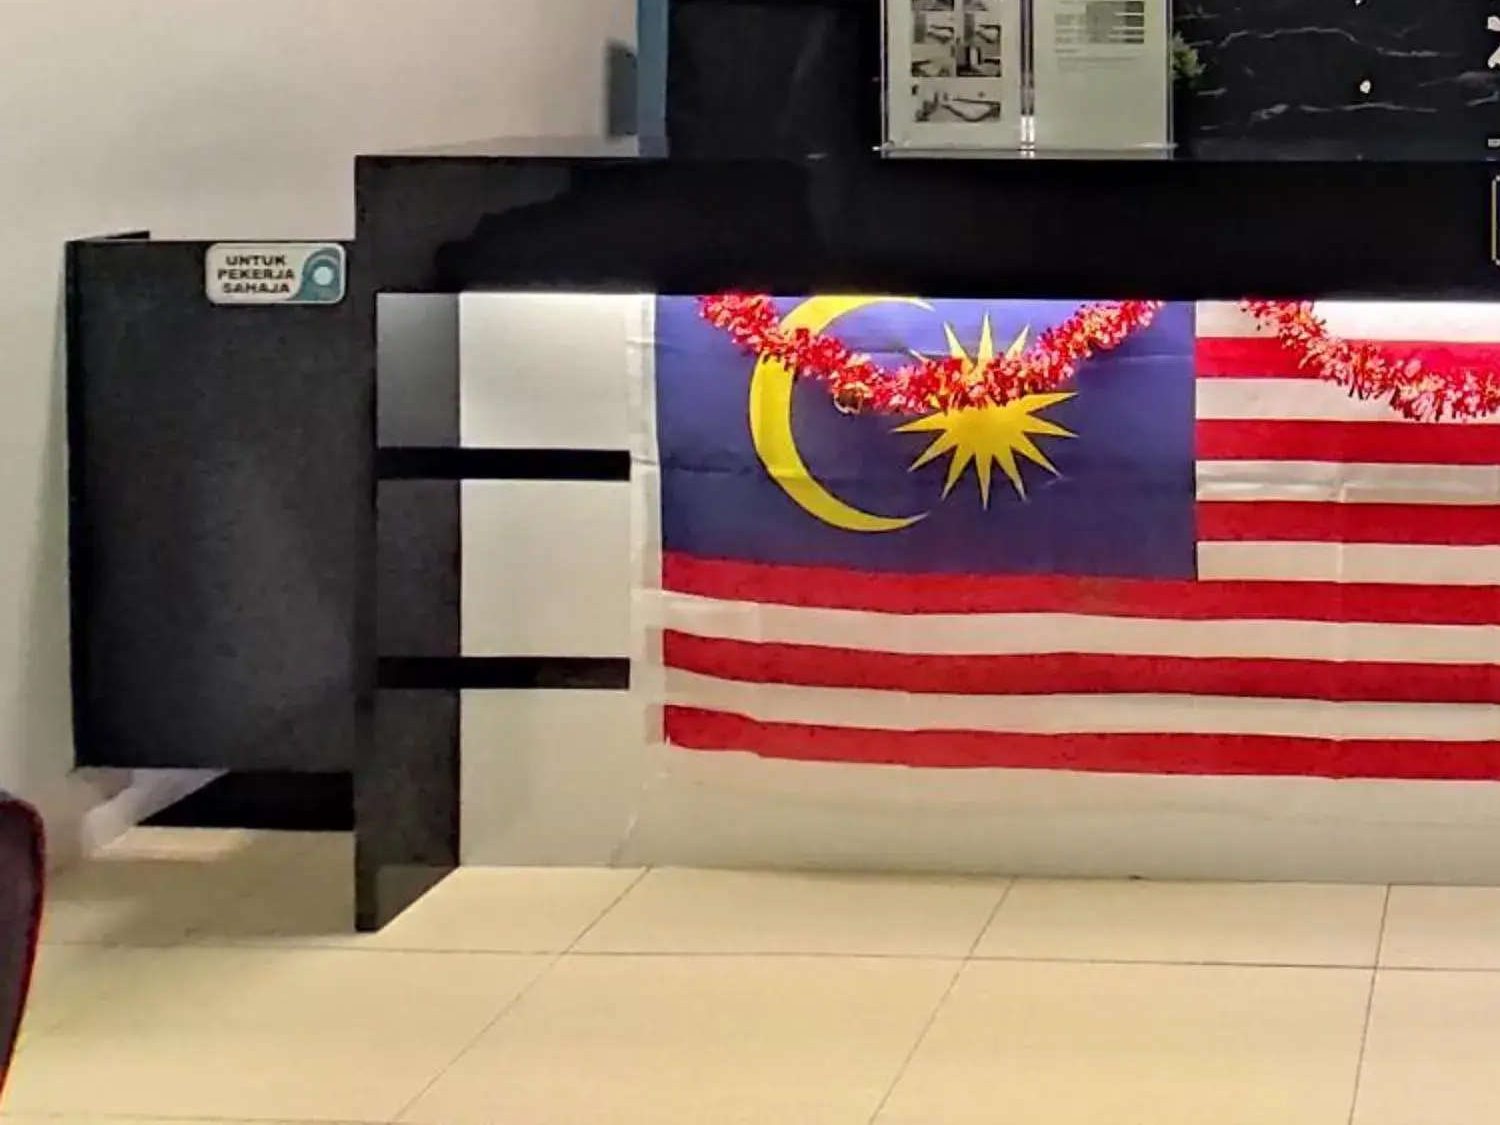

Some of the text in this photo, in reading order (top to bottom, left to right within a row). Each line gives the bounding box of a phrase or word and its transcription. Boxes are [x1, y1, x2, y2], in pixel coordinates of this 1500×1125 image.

[225, 255, 286, 266] UNTUK
[217, 269, 295, 280] PEKERJA
[223, 282, 290, 293] SAHAJA
